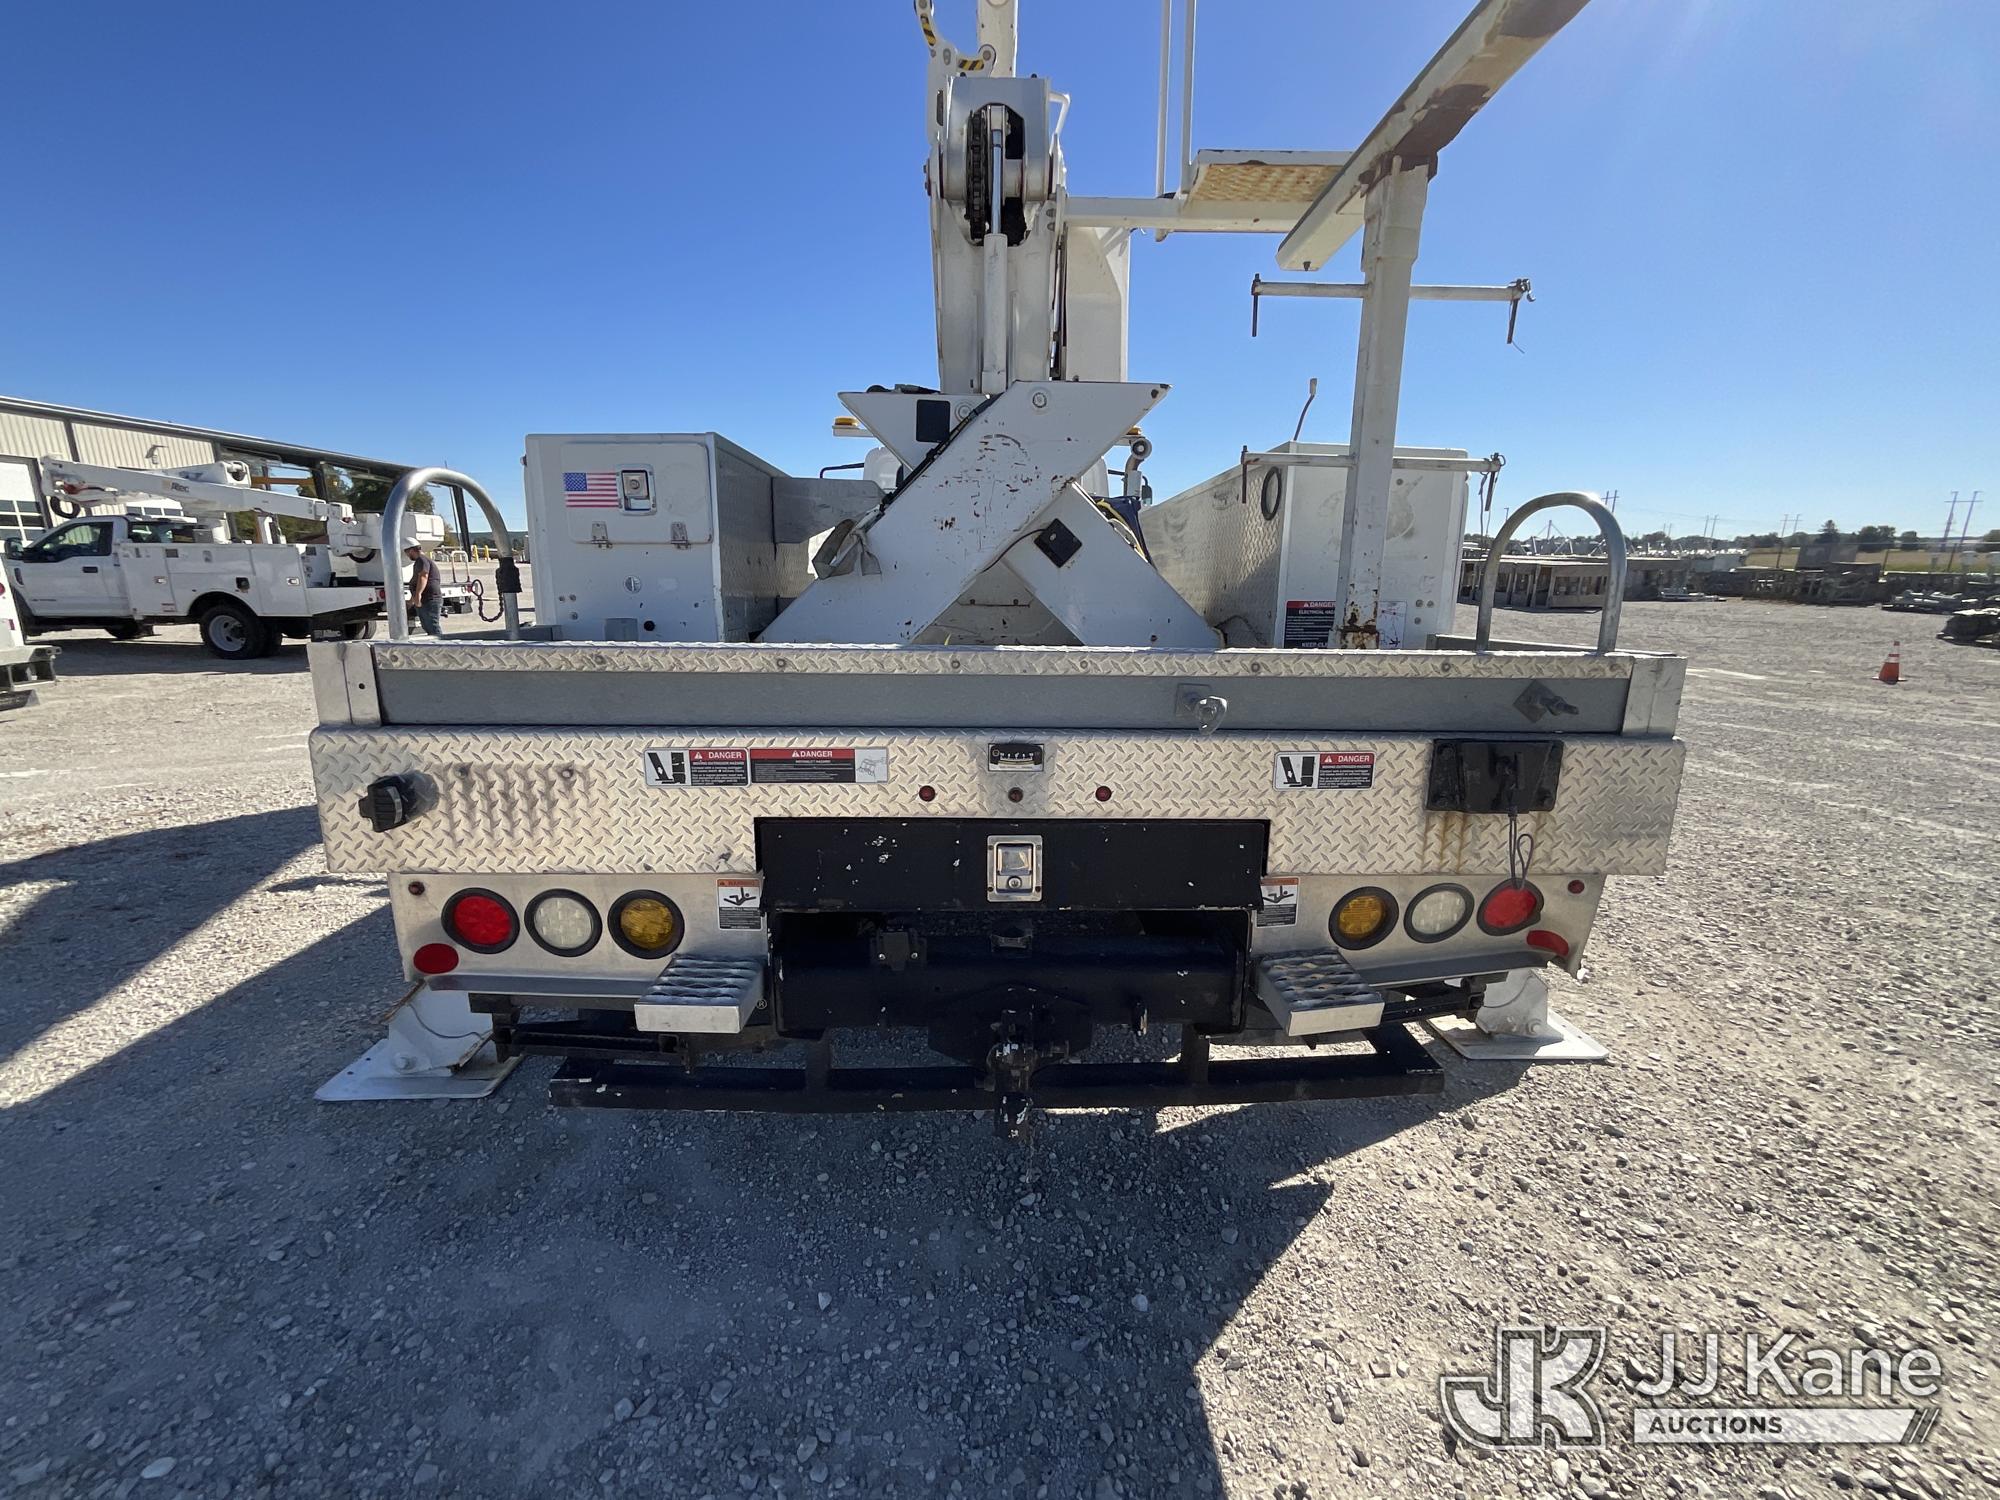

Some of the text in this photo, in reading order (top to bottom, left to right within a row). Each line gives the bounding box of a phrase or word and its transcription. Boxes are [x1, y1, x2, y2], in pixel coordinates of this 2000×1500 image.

[708, 751, 742, 759] DANGER
[800, 750, 833, 758] DANGER
[1338, 755, 1370, 763] DANGER
